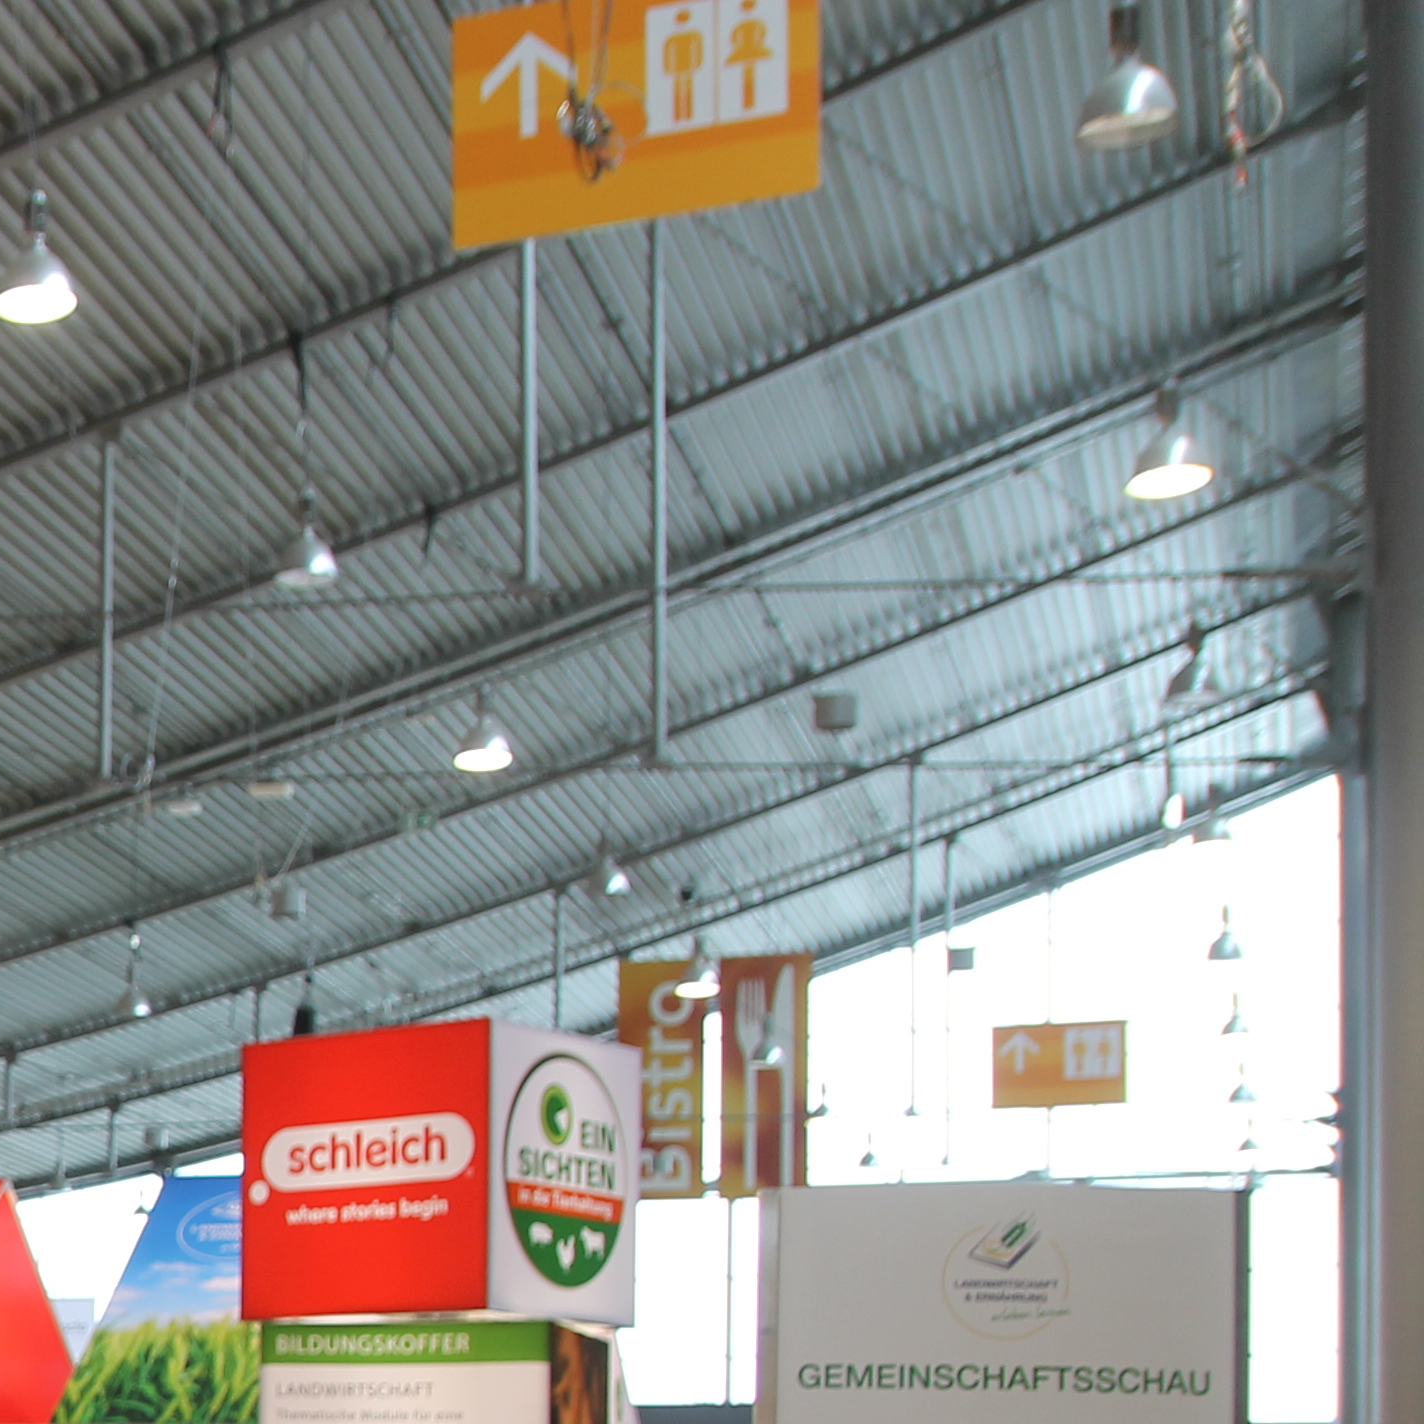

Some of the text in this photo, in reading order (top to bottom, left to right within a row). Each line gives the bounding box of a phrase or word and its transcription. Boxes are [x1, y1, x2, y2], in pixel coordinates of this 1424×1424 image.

[641, 979, 695, 1192] Bistro
[289, 1124, 448, 1175] schleich
[581, 1120, 616, 1153] EIN
[519, 1147, 616, 1190] SICHTEN
[285, 1194, 450, 1226] where stories begin
[275, 1331, 472, 1357] BILDUNGSKOFFER
[275, 1381, 435, 1397] LANDWIRTSCHAFT
[798, 1363, 1212, 1396] GEMEINSCHAFTSSCHAU
